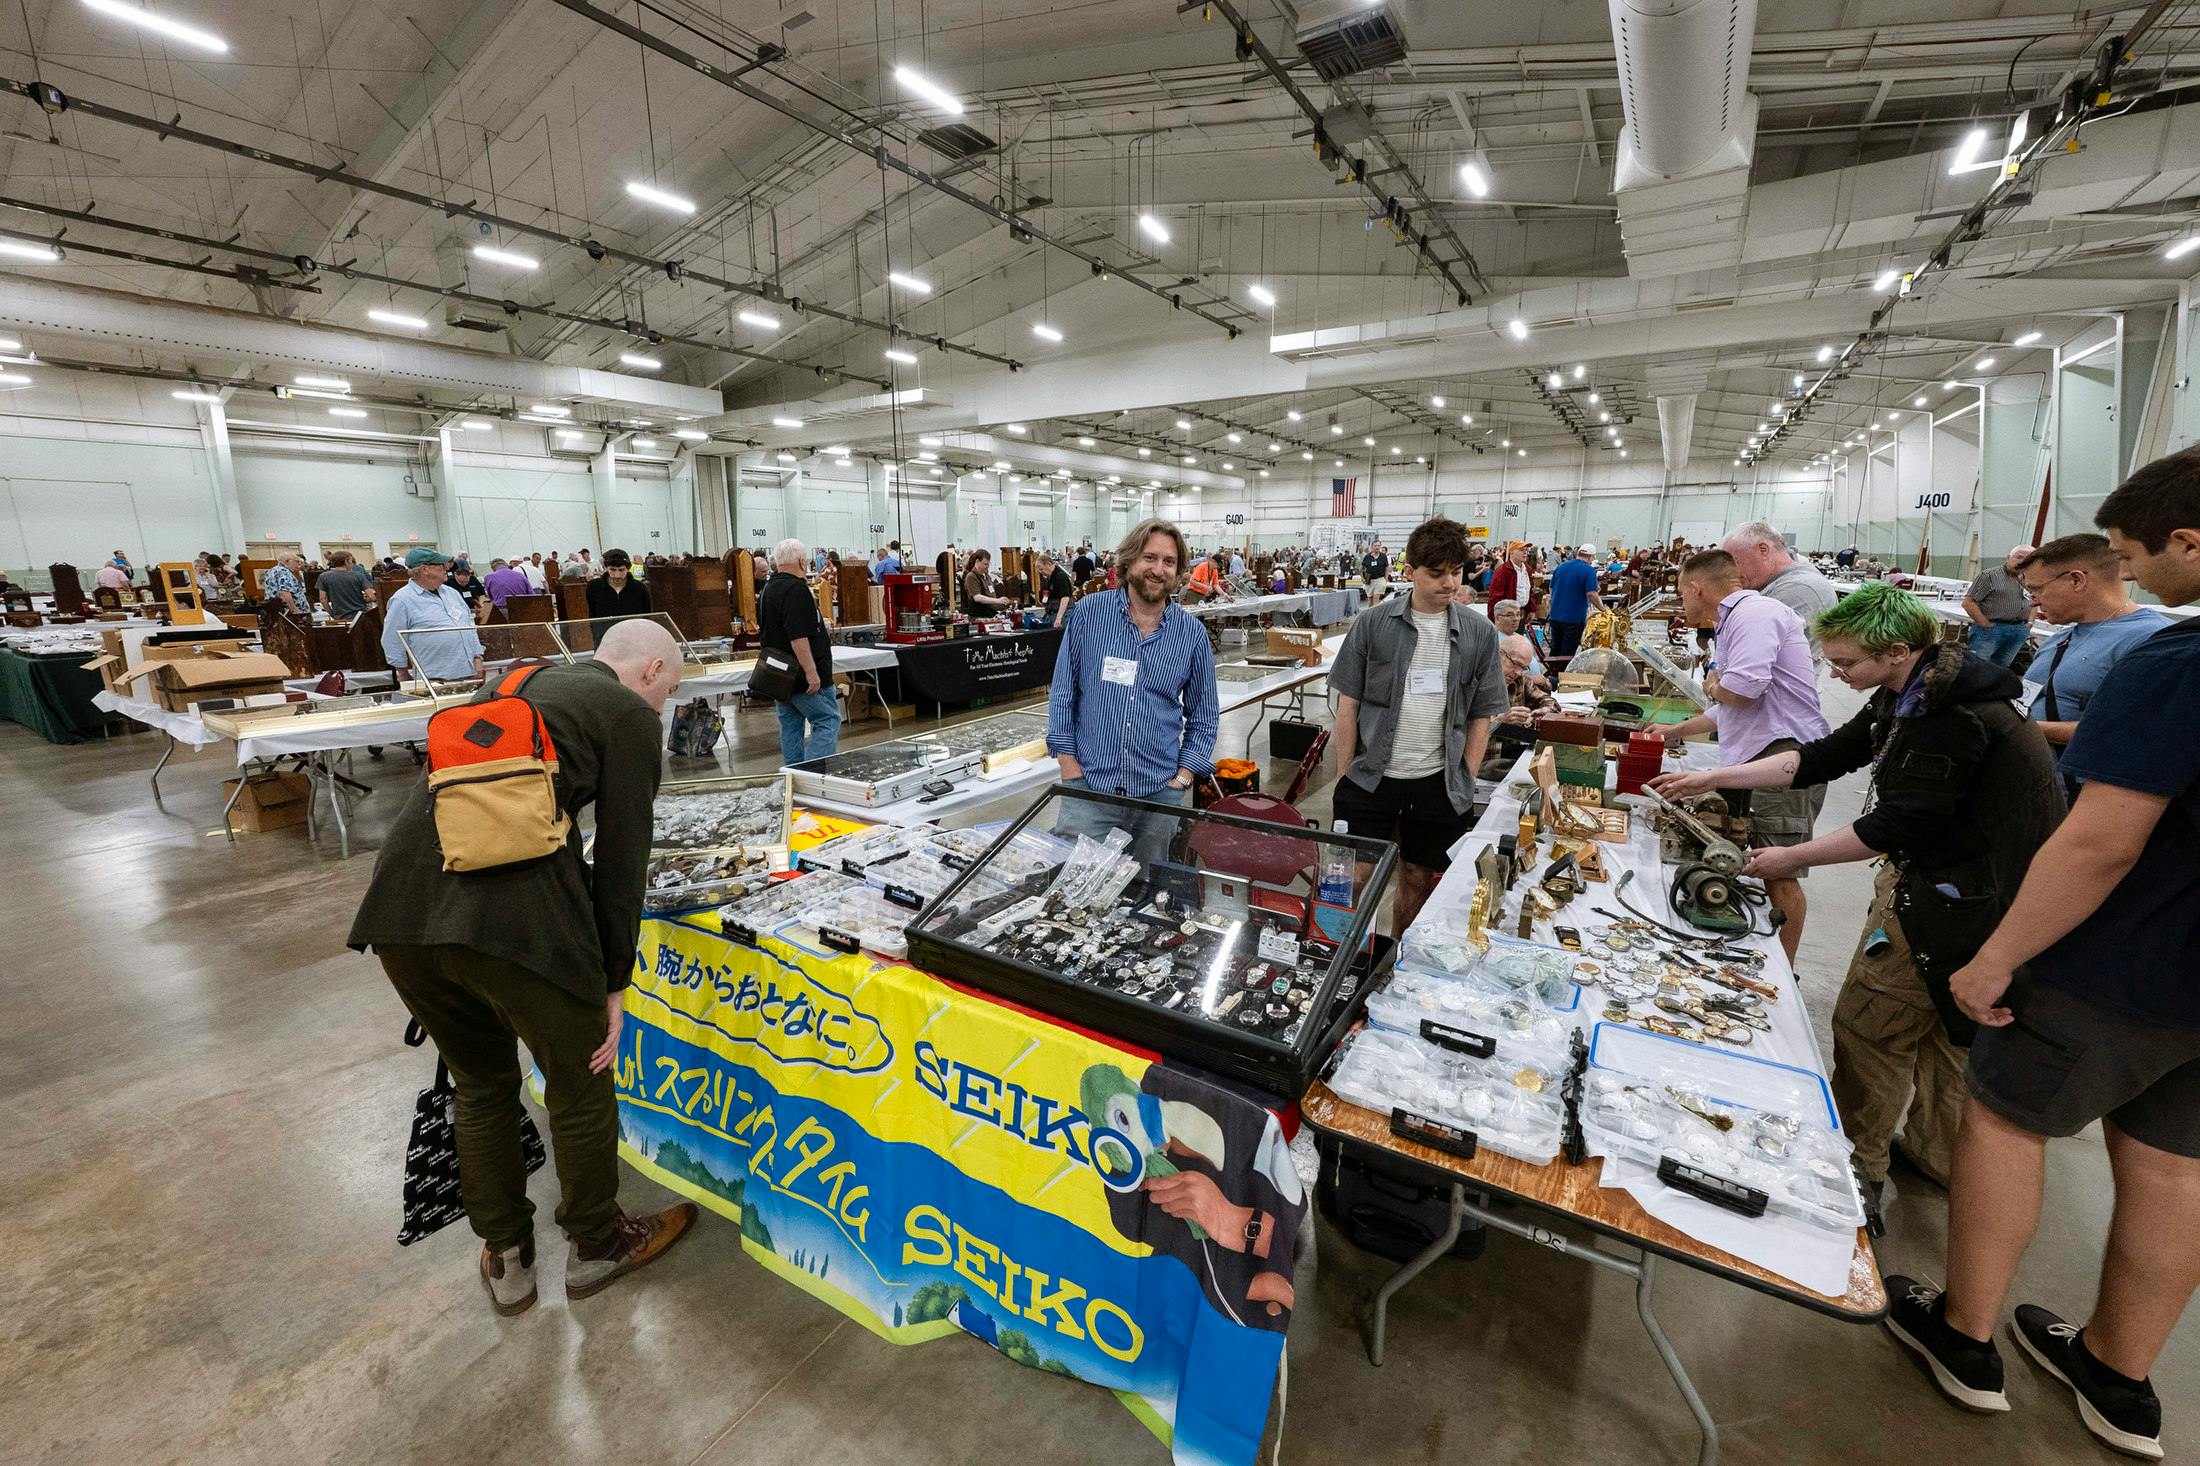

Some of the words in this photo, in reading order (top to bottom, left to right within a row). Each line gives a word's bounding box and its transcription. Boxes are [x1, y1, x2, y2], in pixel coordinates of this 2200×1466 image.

[1915, 493, 1950, 509] J400
[1504, 504, 1519, 518] H400
[1024, 520, 1035, 530] F400
[1226, 514, 1244, 525] G400
[752, 529, 767, 537] D400
[870, 525, 885, 534] E400
[915, 1041, 1144, 1190] SEIKO
[902, 1204, 1145, 1364] SEIKO
